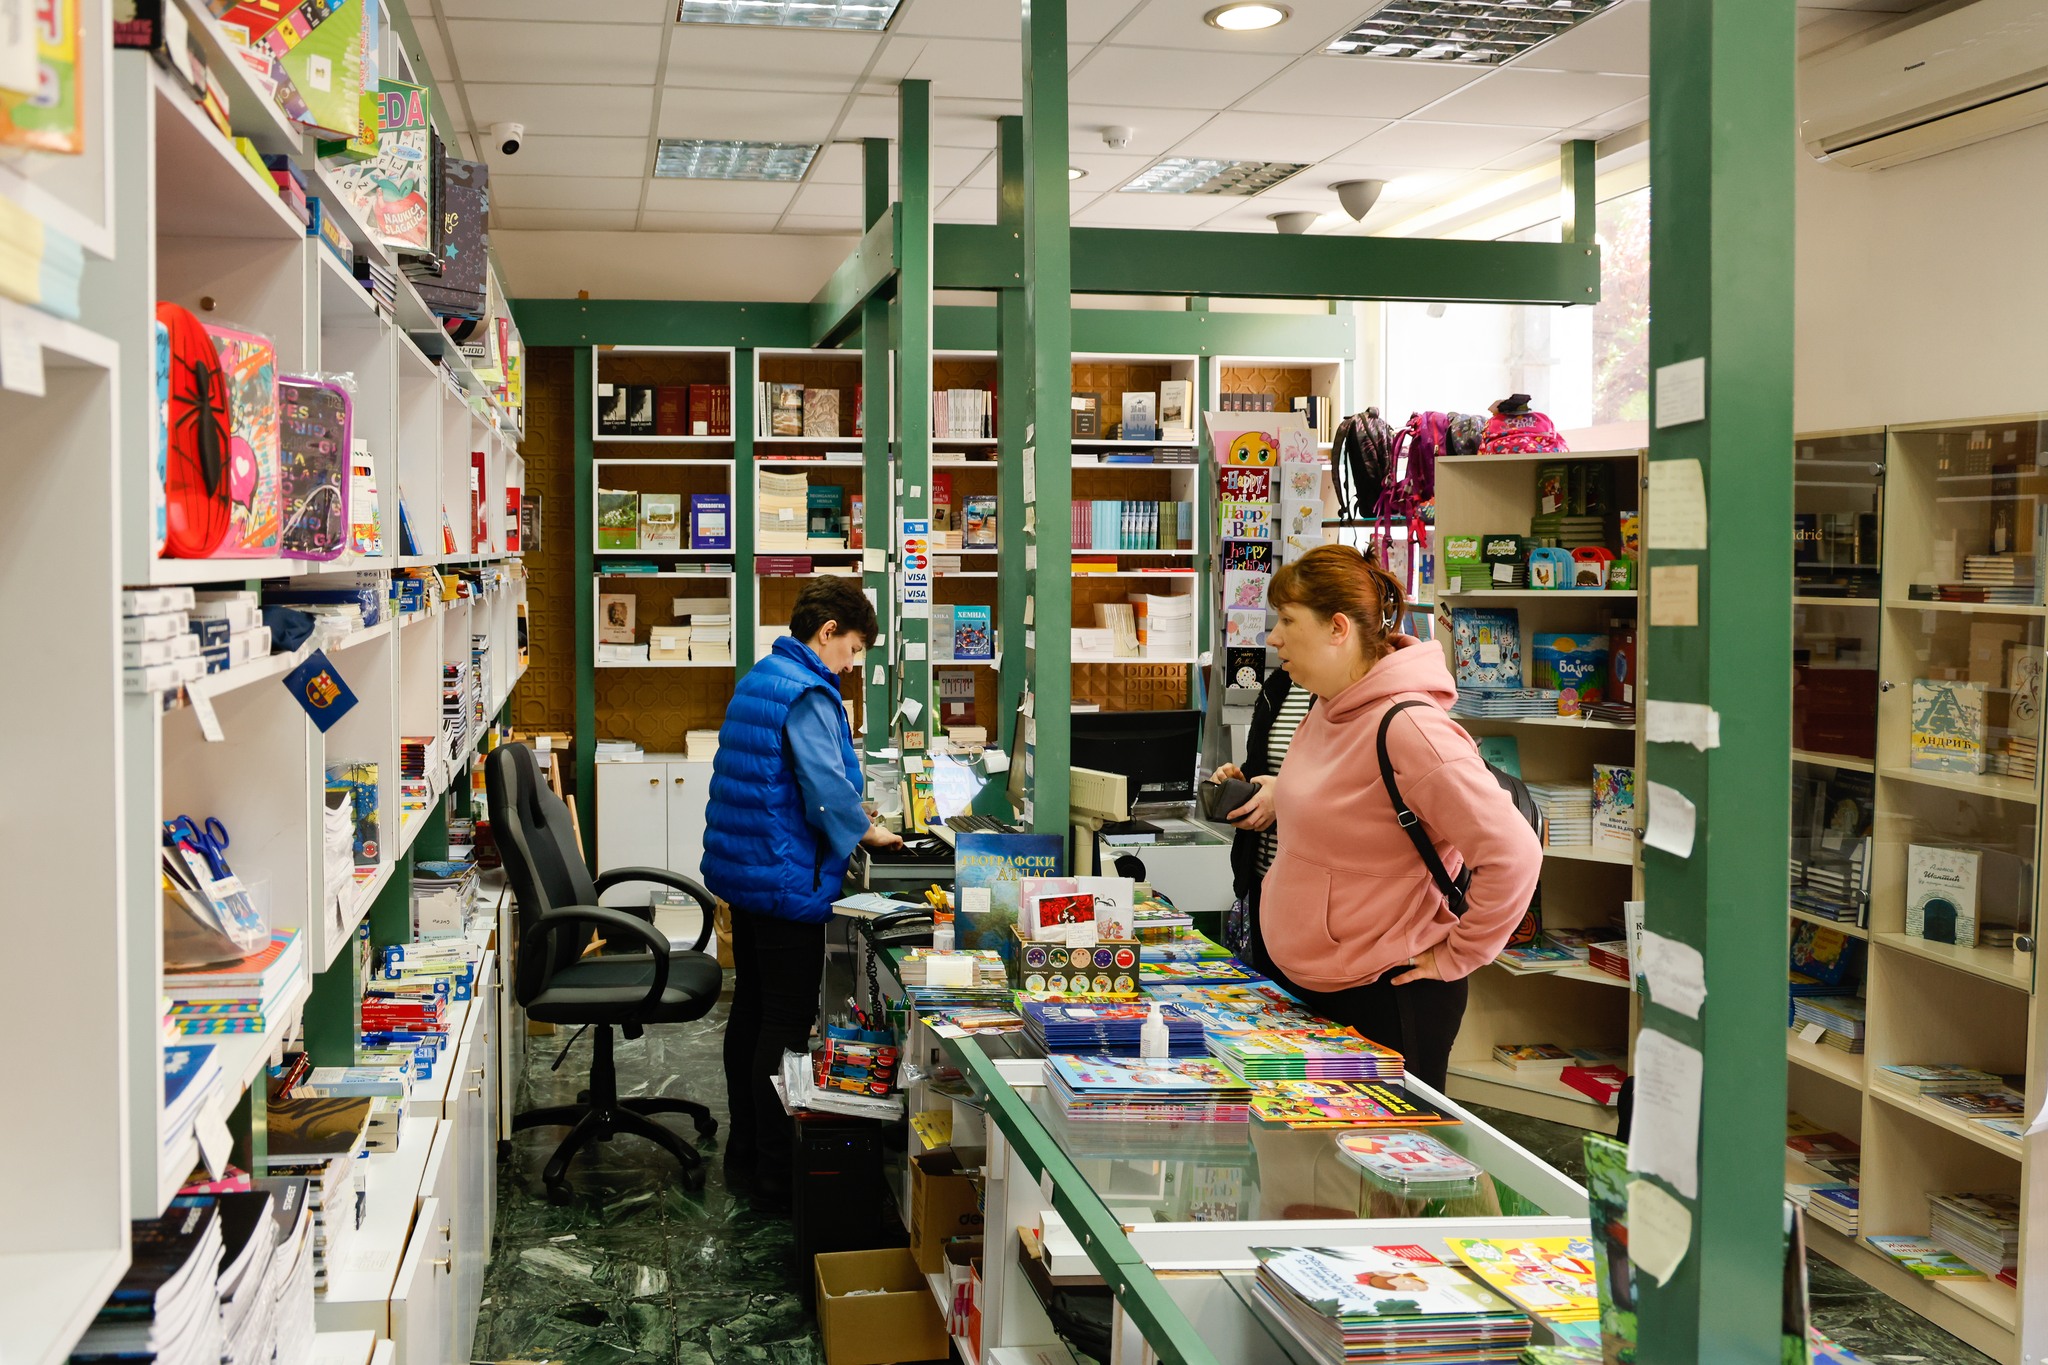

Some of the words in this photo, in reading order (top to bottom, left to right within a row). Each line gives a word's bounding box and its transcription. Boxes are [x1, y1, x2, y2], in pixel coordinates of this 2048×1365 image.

[378, 90, 425, 129] EDA
[383, 203, 420, 224] NAUKICA
[1227, 470, 1264, 494] Happy
[1223, 505, 1270, 522] Happy
[1233, 521, 1269, 538] Birth
[1230, 541, 1267, 560] happy
[907, 573, 926, 581] VISA
[907, 590, 926, 598] VISA
[1559, 659, 1595, 678] Бајке
[1919, 736, 1972, 749] АНДРИЋ
[963, 855, 1055, 867] ГЕОГРАФСКИ
[996, 867, 1055, 881] АТЛАС
